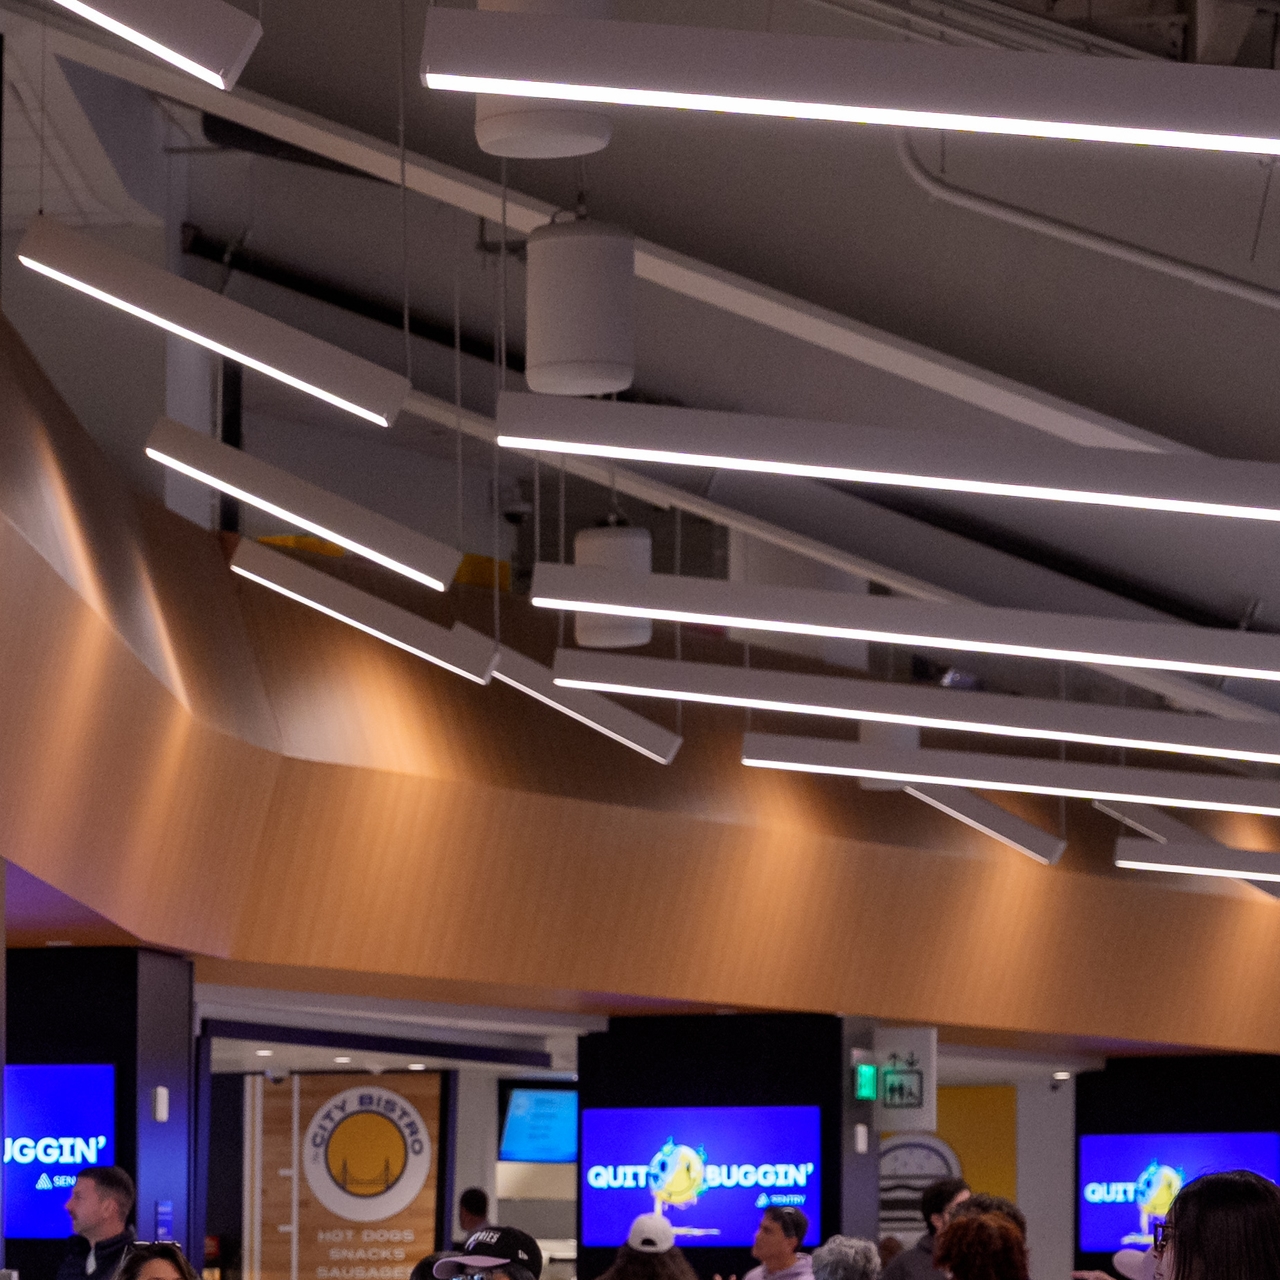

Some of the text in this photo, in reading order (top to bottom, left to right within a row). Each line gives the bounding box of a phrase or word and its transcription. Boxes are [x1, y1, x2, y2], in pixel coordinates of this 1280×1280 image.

[312, 1093, 424, 1156] CITY BISTRO
[587, 1162, 814, 1190] QUIT BUGGIN'
[1083, 1182, 1139, 1204] QUIT
[361, 1229, 415, 1243] DOGS
[329, 1247, 406, 1261] SNACKS
